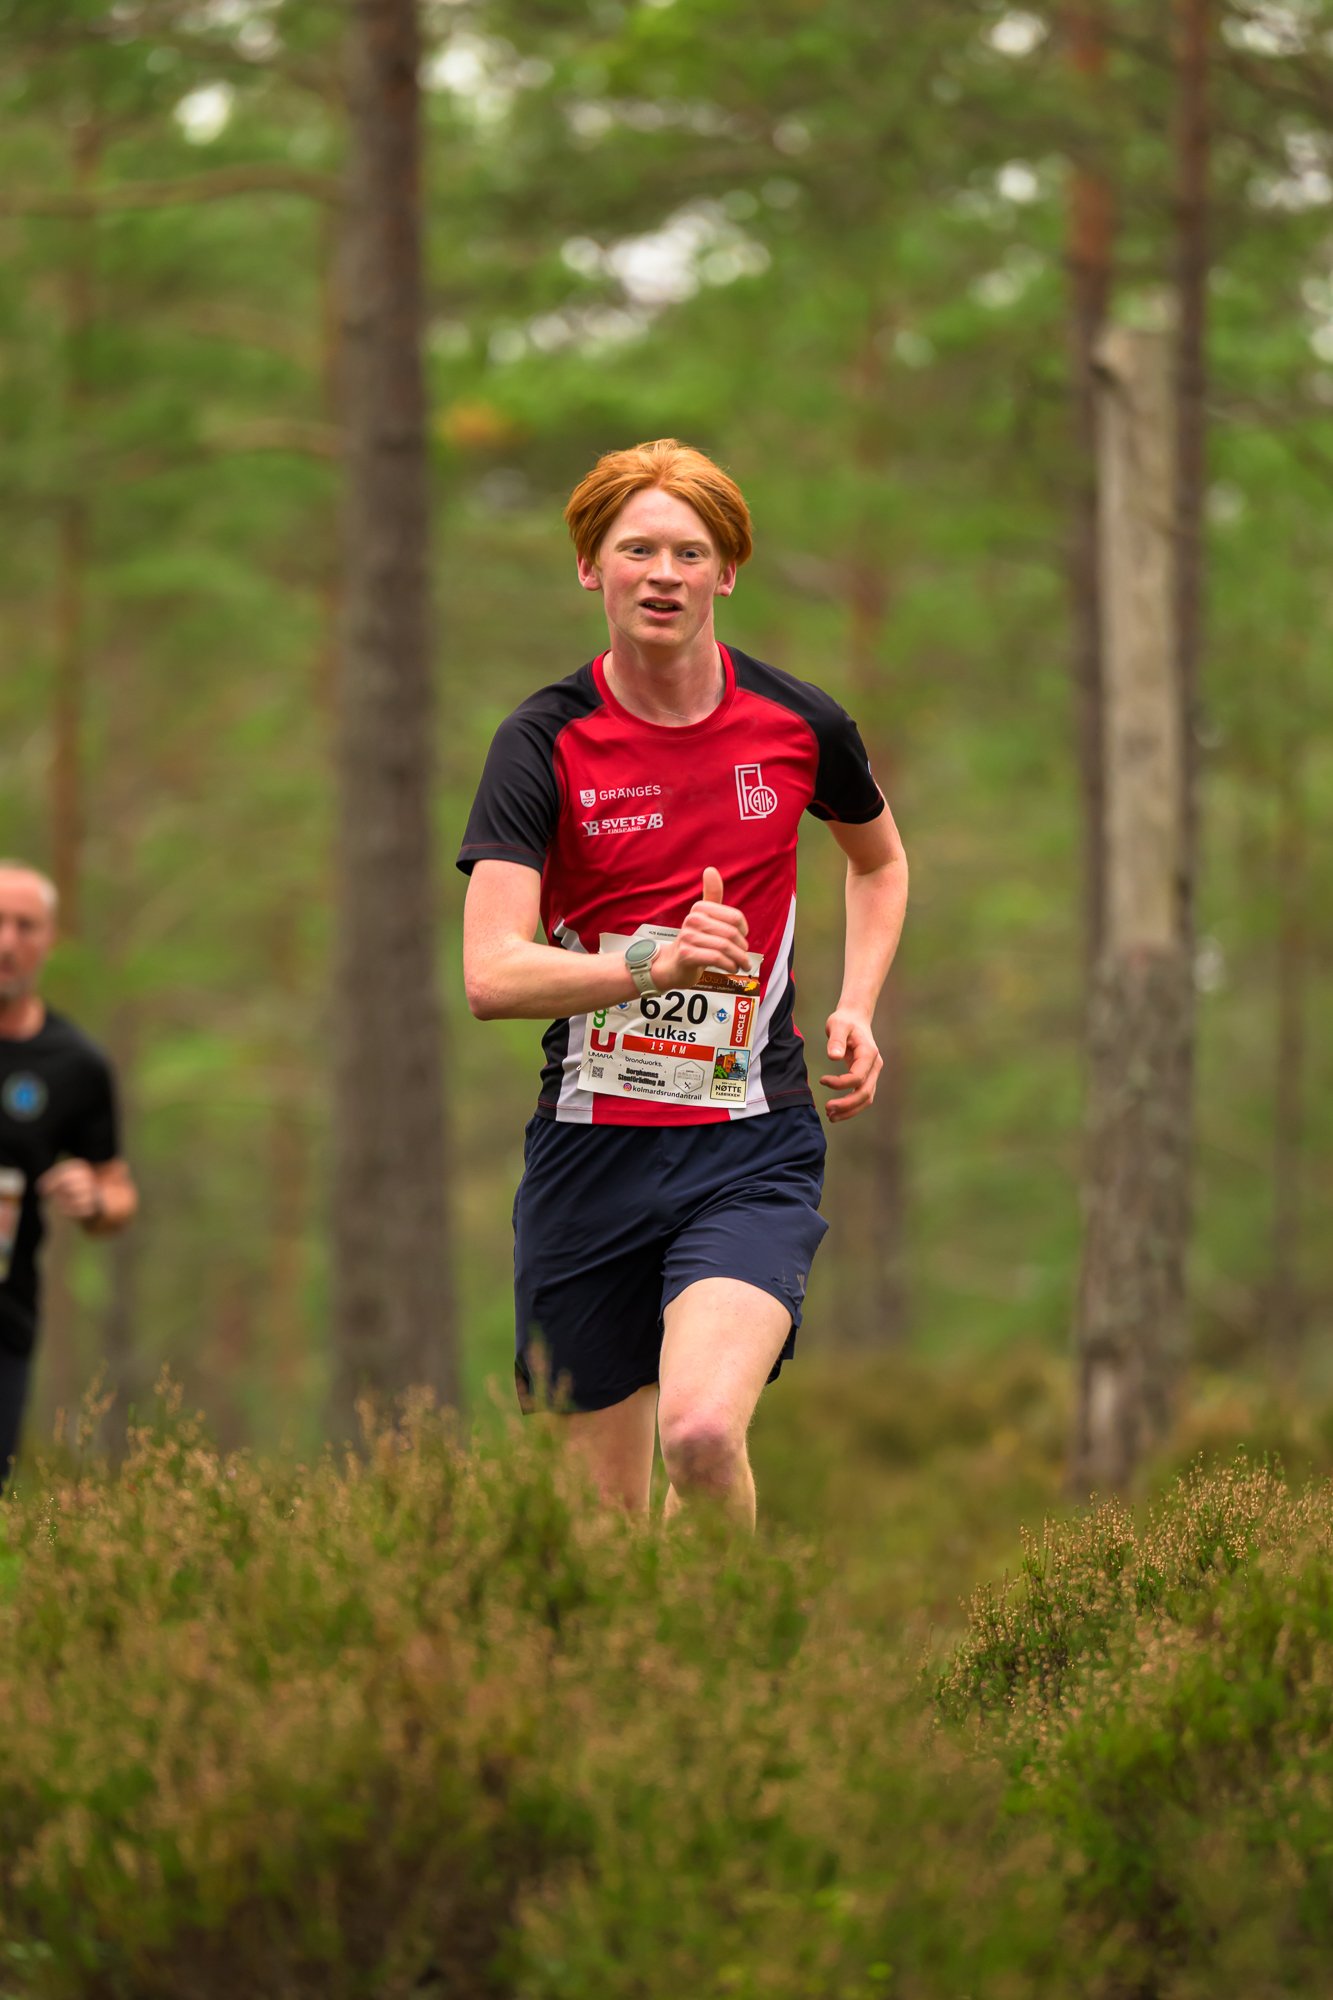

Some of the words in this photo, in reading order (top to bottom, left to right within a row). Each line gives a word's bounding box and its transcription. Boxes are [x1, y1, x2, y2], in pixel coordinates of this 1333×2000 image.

[599, 785, 662, 801] GRÄNGES
[601, 815, 647, 829] SVETS
[646, 813, 664, 829] AB
[640, 991, 708, 1025] 620
[644, 1023, 697, 1043] Lukas
[735, 1013, 747, 1044] CIRCLE
[588, 1051, 614, 1060] UMARA
[651, 1042, 664, 1052] 15
[671, 1044, 687, 1054] KM
[657, 1079, 666, 1087] AB
[715, 1084, 742, 1094] NØTTE
[633, 1085, 702, 1101] kolmardsrundantrail
